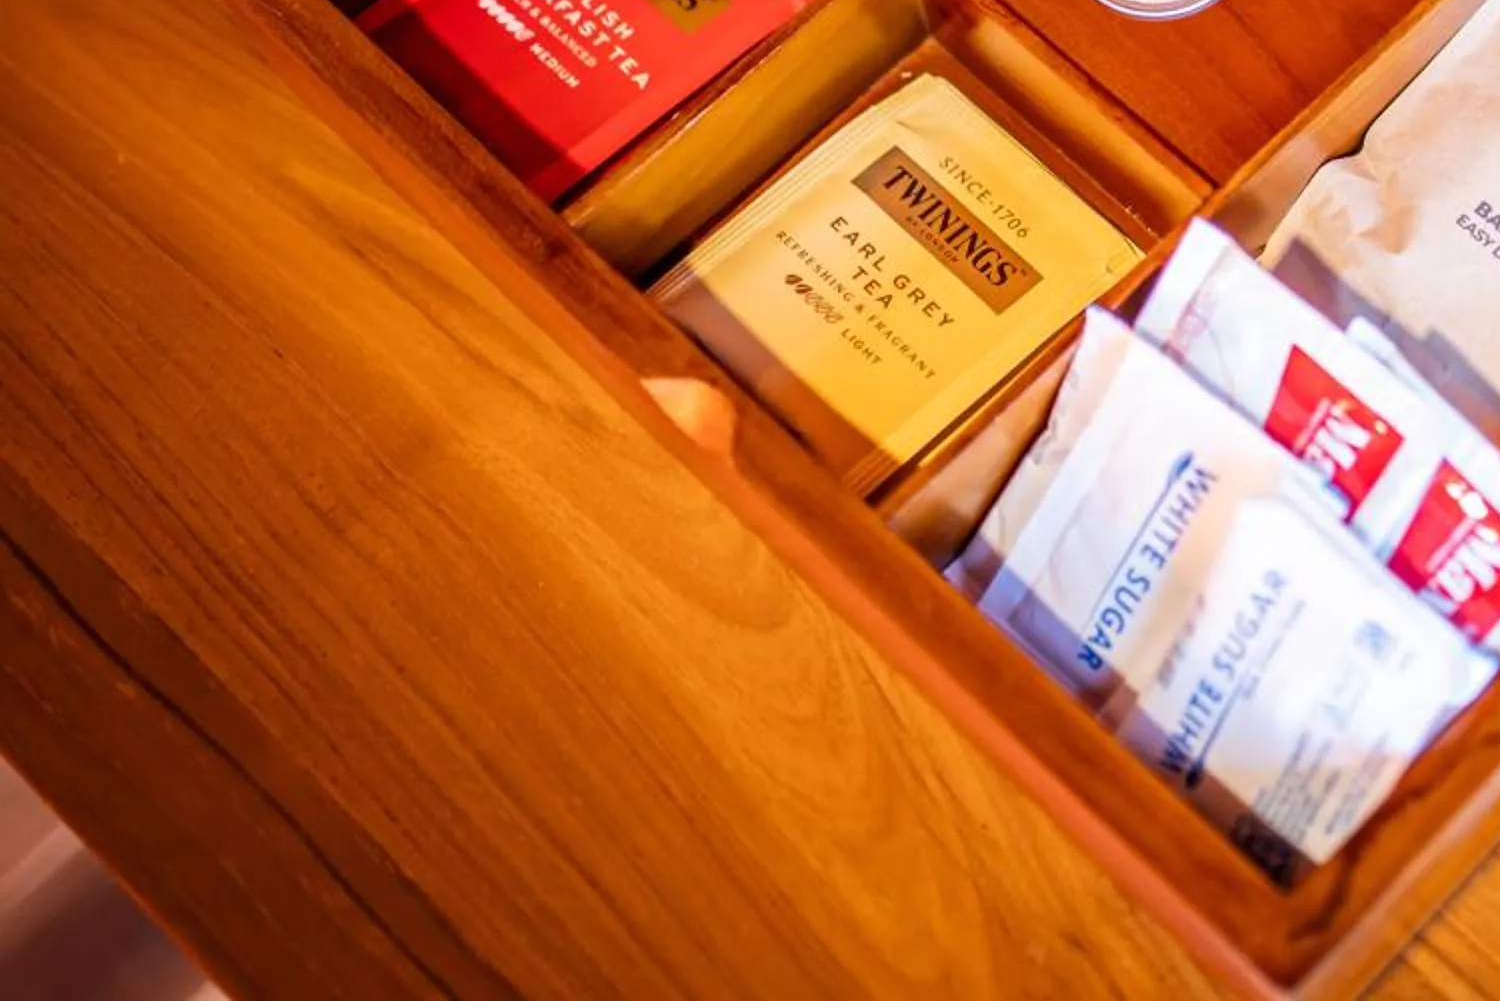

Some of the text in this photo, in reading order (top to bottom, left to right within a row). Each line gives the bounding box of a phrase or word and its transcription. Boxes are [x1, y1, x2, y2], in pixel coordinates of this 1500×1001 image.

[529, 6, 541, 18] &
[539, 15, 598, 67] BALANCED
[530, 42, 580, 88] MEDIUM
[609, 45, 650, 90] TEA
[883, 165, 1018, 286] TWININGS
[1455, 214, 1495, 248] EASY
[775, 230, 936, 380] REFRESHING & FRAGRANT
[830, 216, 955, 328] EARL GREY
[851, 265, 893, 309] TEA
[841, 328, 883, 366] LIGHT
[1140, 467, 1219, 570] WHITE
[1077, 567, 1151, 672] SUGAR
[1158, 679, 1222, 775] WHITE
[1212, 569, 1287, 681] SUGAR
